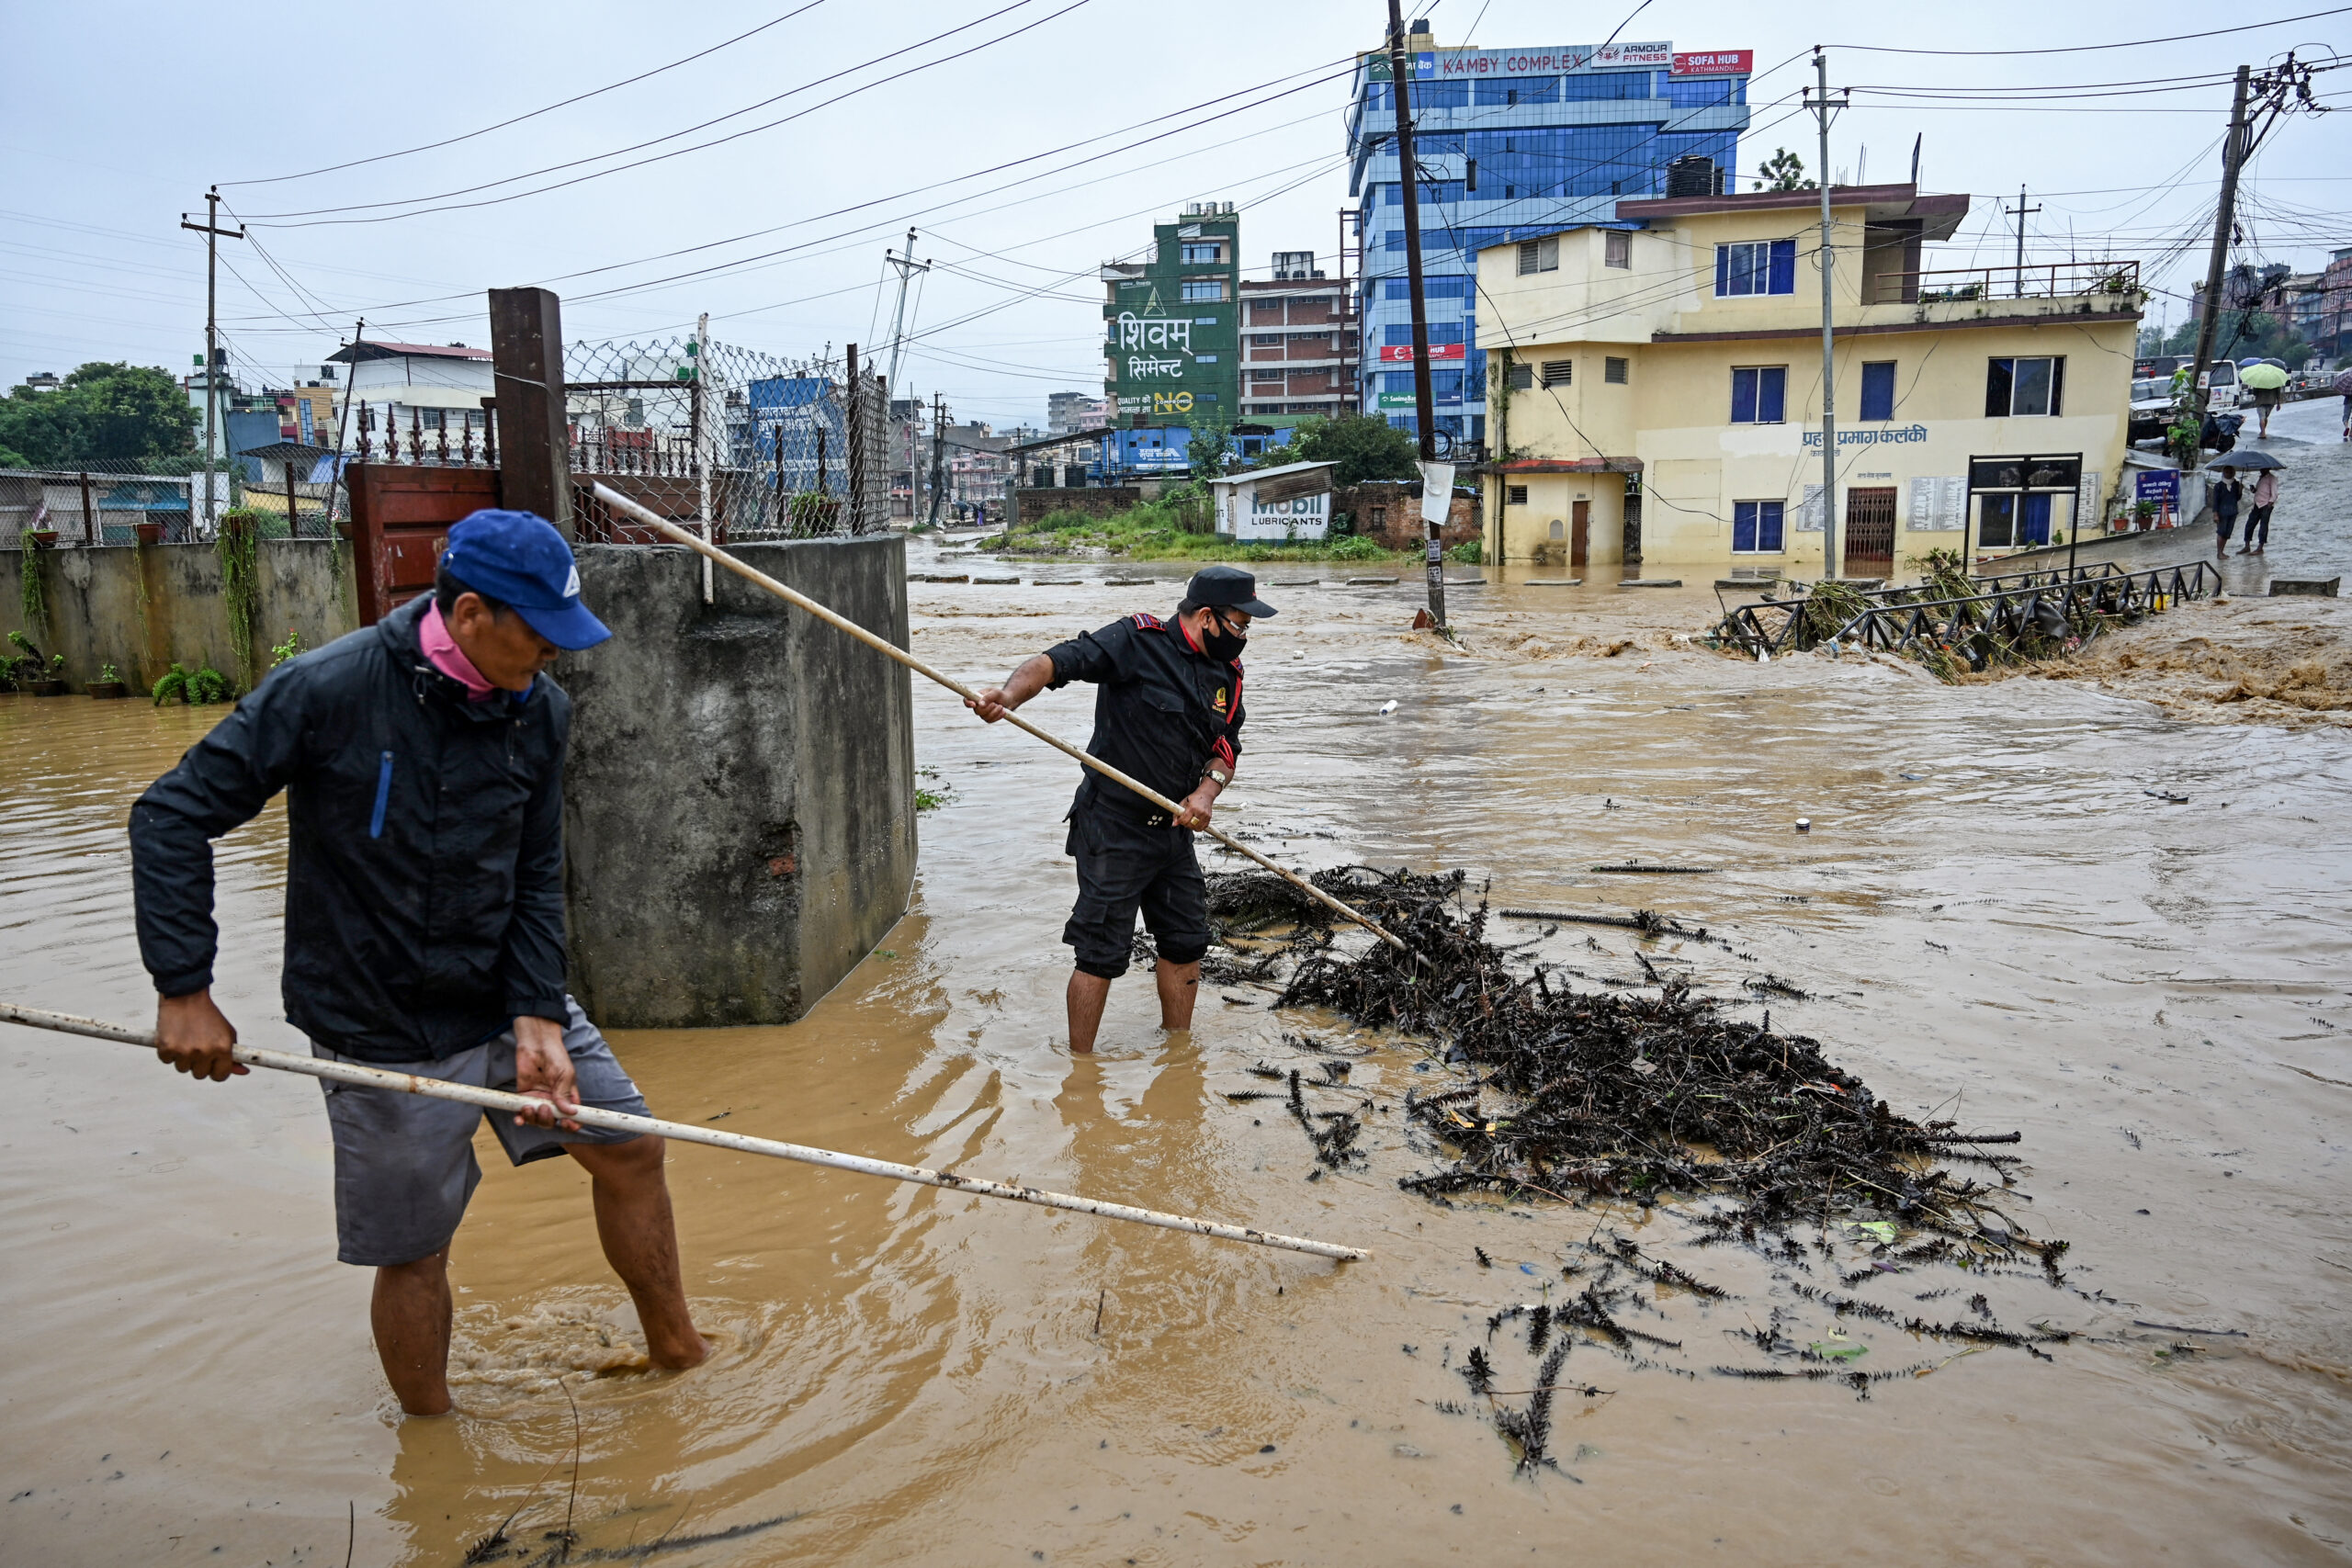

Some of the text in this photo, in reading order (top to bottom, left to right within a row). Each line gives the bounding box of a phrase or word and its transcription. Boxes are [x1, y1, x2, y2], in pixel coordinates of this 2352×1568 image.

[1623, 44, 1668, 53] ARMOUR
[1443, 54, 1583, 73] KAMBY COMPLEX
[1623, 53, 1668, 62] FITNESS
[1688, 53, 1739, 66] SOFA HUB
[1690, 65, 1735, 73] KATHMANDU
[1117, 311, 1193, 356] शिवम्
[1127, 354, 1183, 381] सिमेन्ट
[1117, 397, 1140, 406] QUALITY
[1154, 391, 1193, 412] NO
[1838, 430, 1879, 446] प्रभाग
[1880, 423, 1928, 444] कलंकी
[1251, 517, 1322, 525] LUBRICANTS
